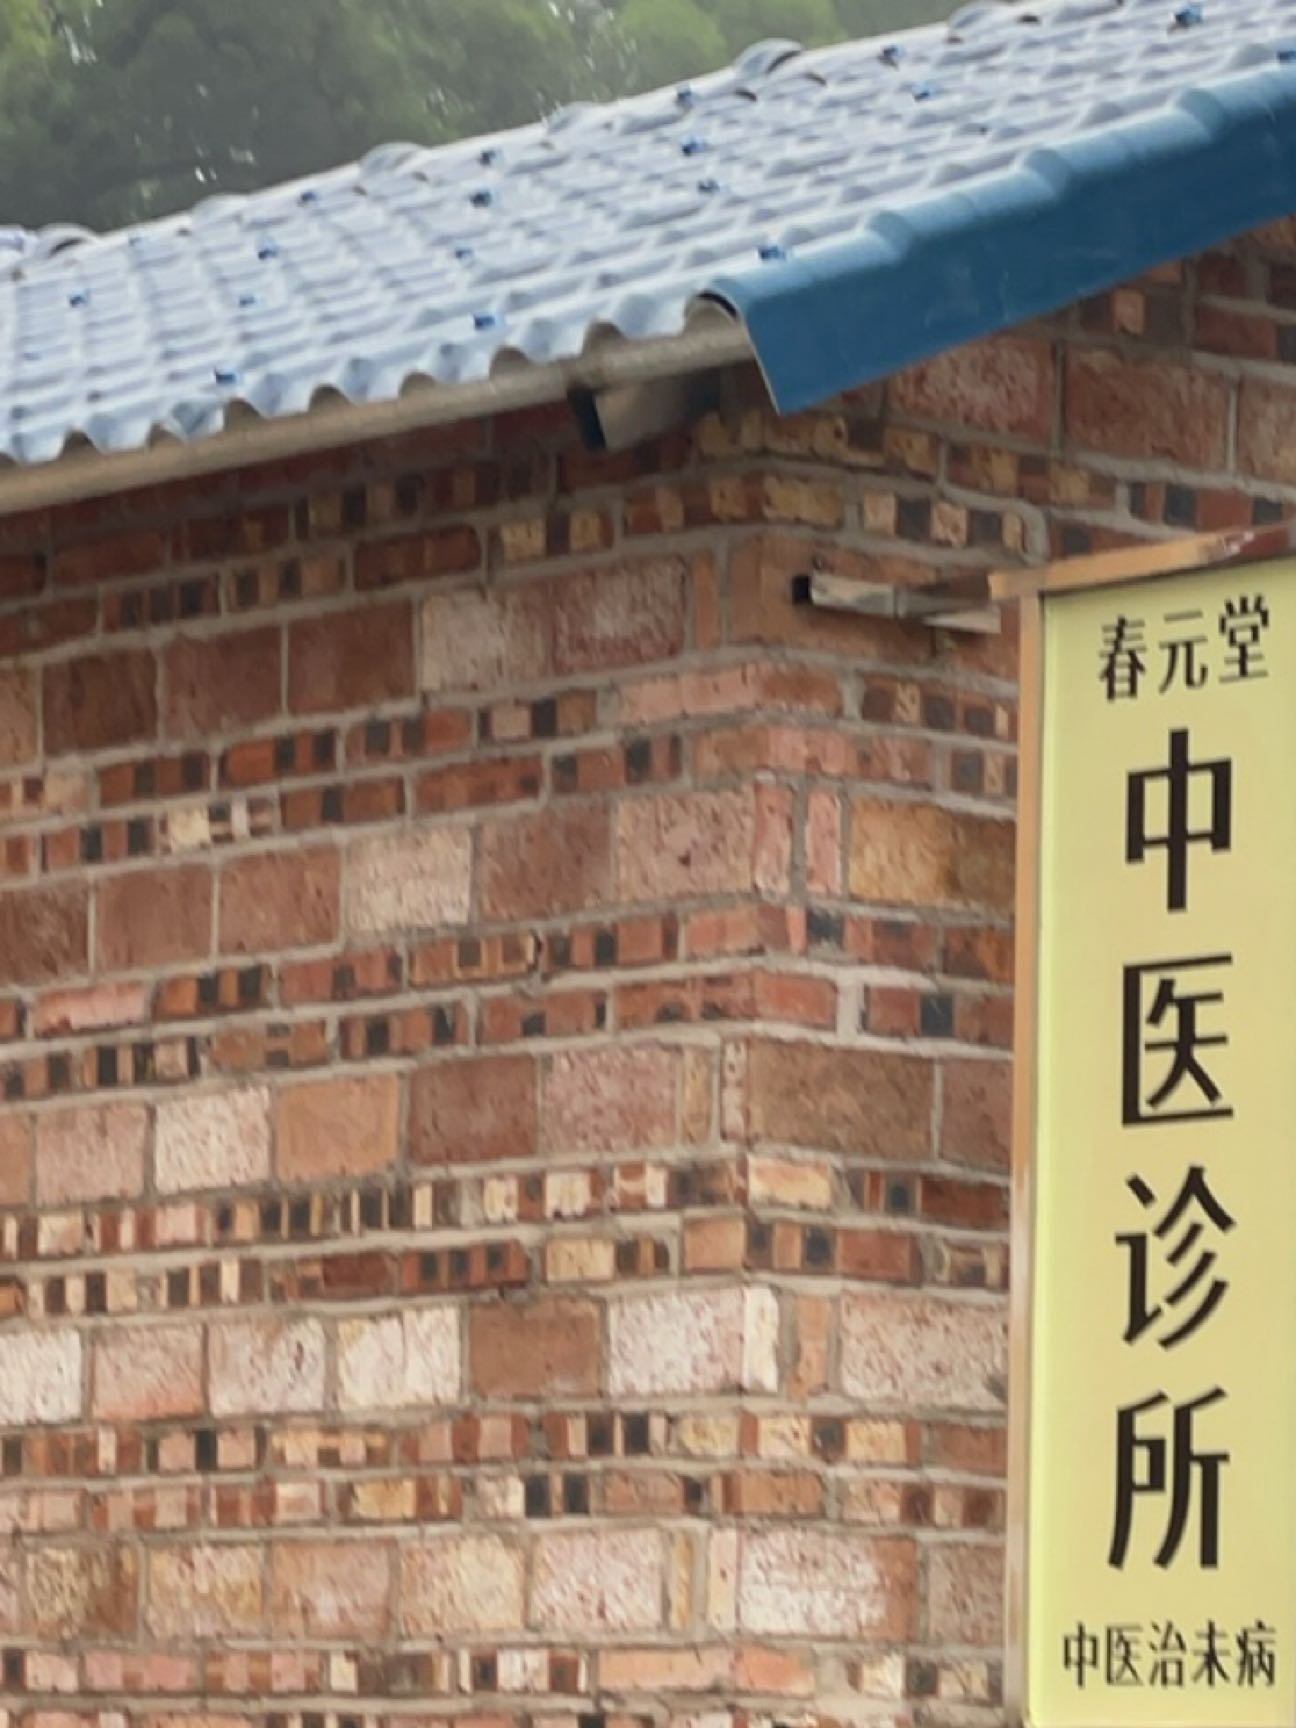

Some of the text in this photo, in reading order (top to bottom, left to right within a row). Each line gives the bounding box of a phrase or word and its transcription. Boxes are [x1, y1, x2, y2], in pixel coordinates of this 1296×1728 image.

[1099, 593, 1270, 701] 春元堂
[1108, 727, 1237, 1571] 中医诊所
[1063, 1619, 1277, 1690] 中医治未病
